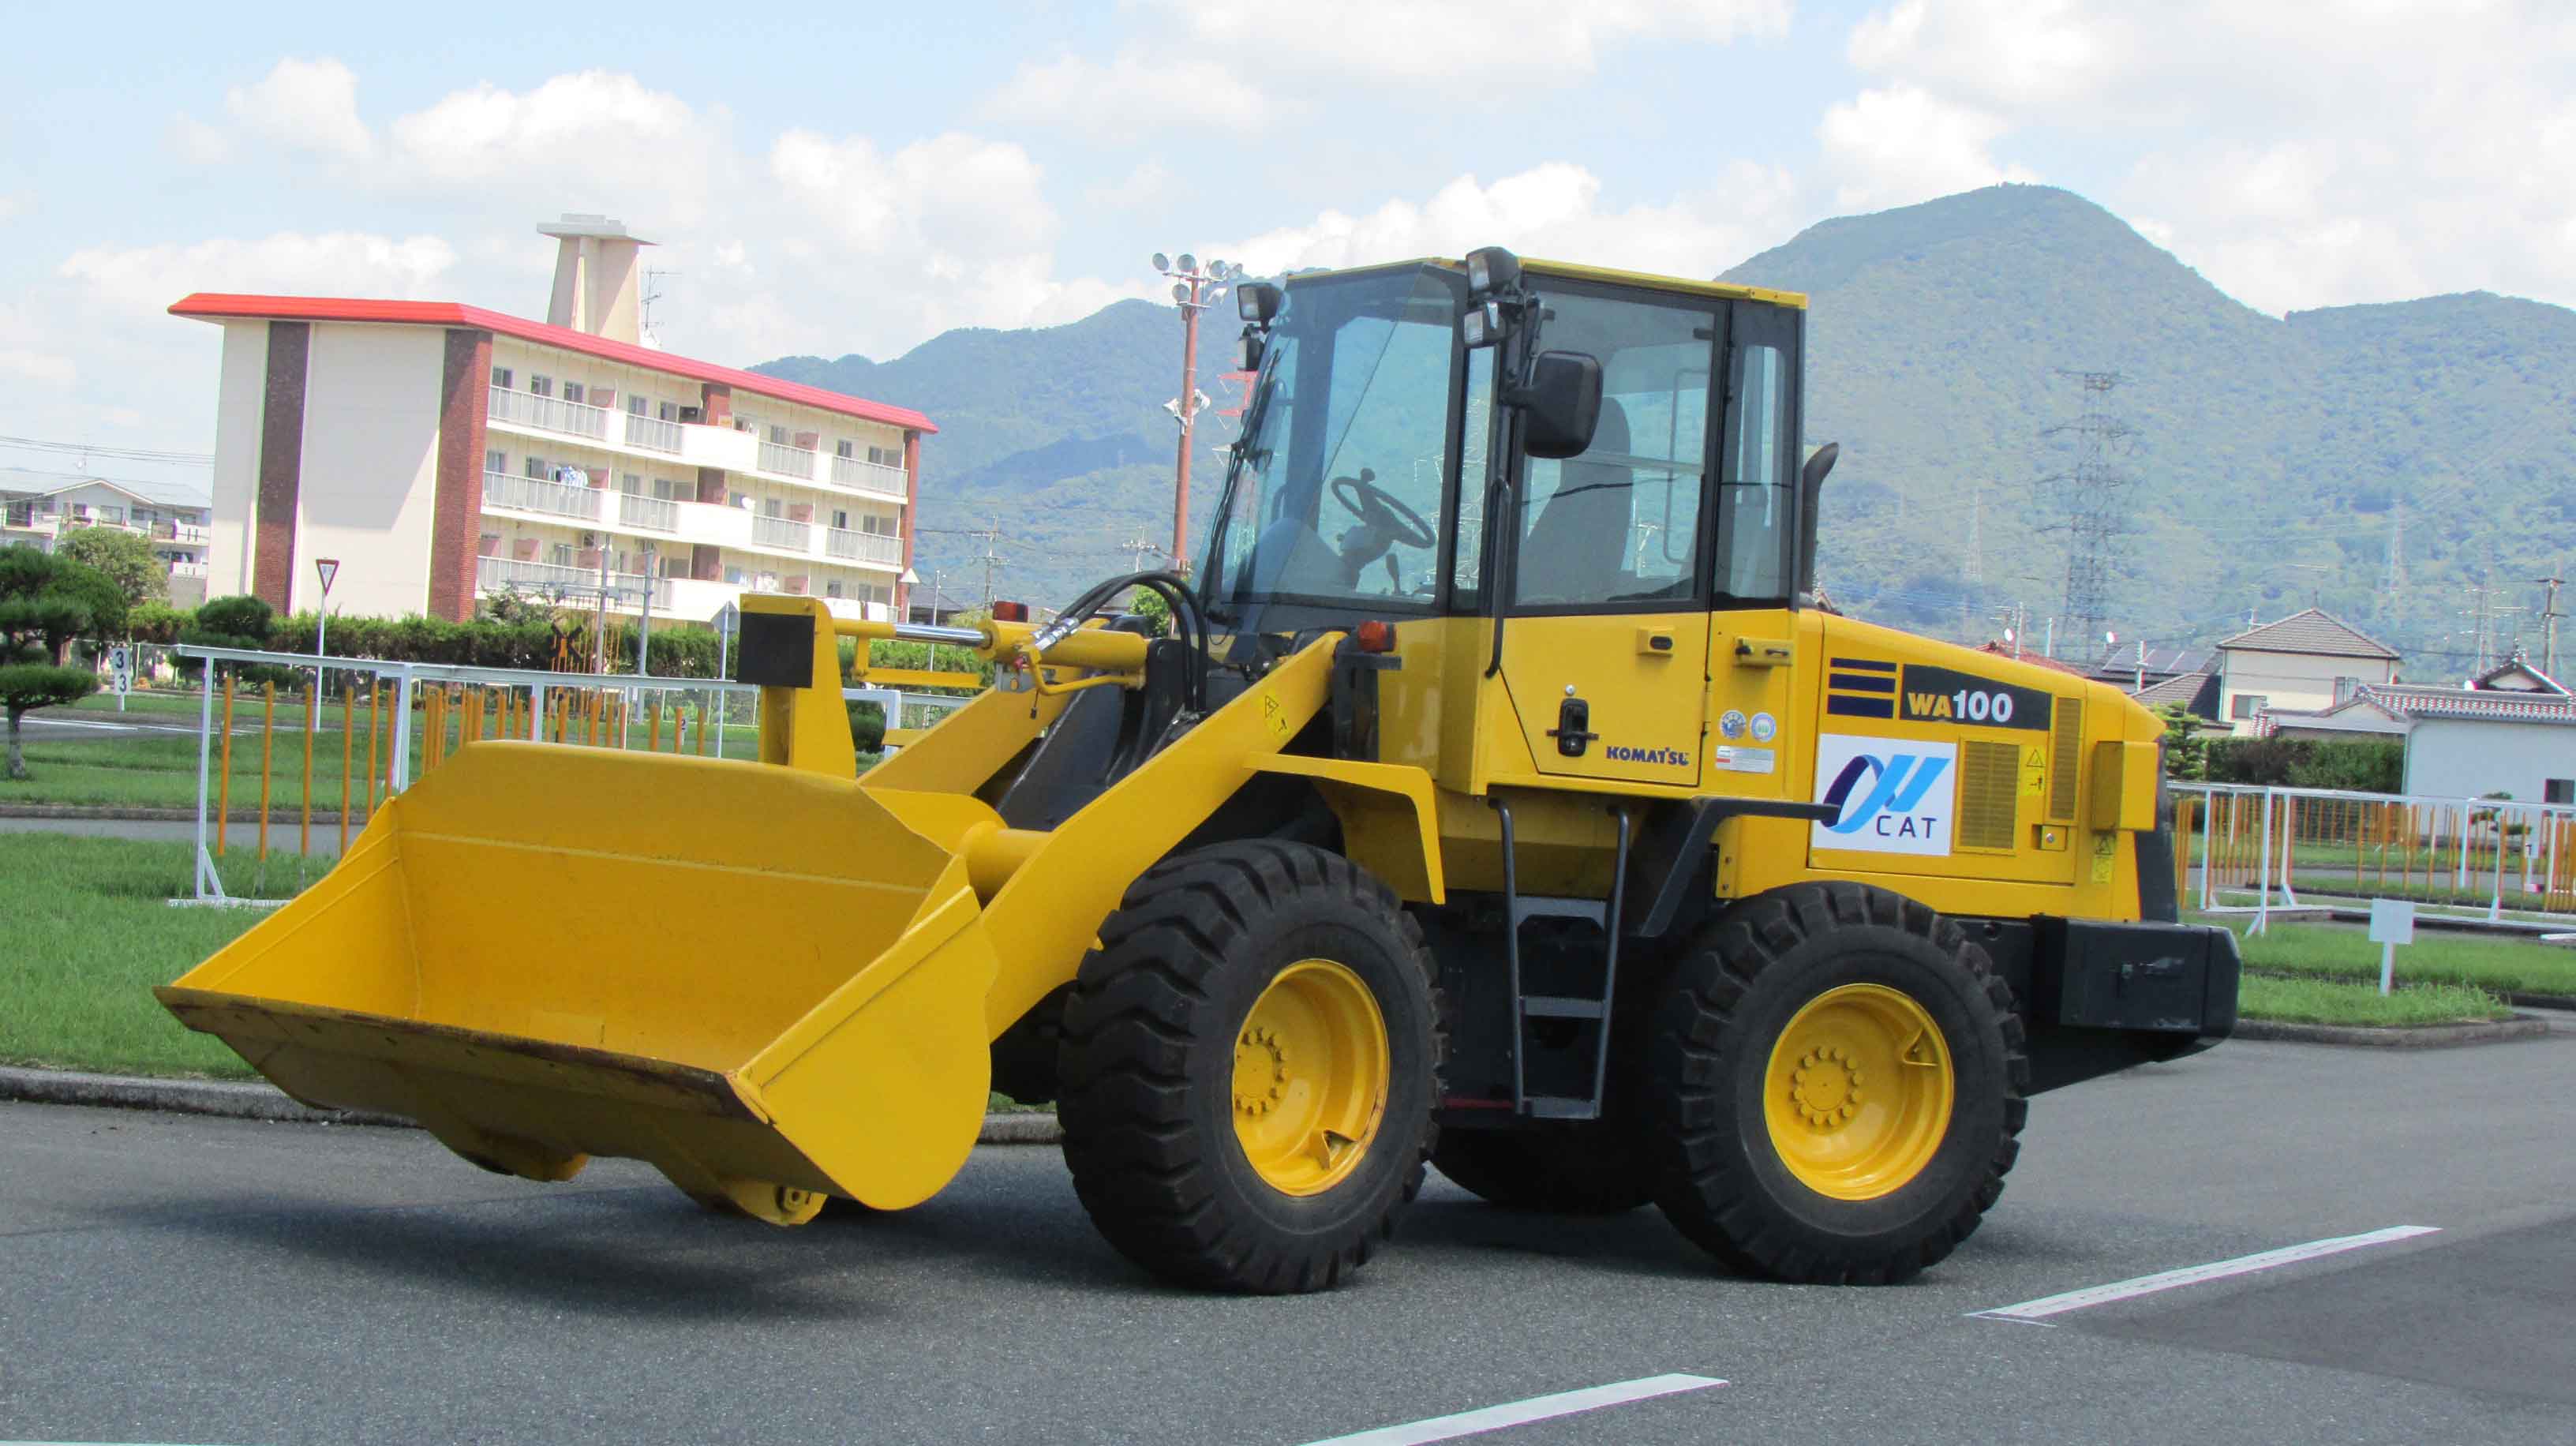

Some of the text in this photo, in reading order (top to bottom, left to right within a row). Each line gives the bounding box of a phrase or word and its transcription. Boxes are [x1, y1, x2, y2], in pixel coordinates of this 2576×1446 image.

[116, 650, 124, 669] 3
[119, 674, 127, 691] 3
[1908, 690, 2013, 722] WA100
[1876, 815, 1937, 839] CAT
